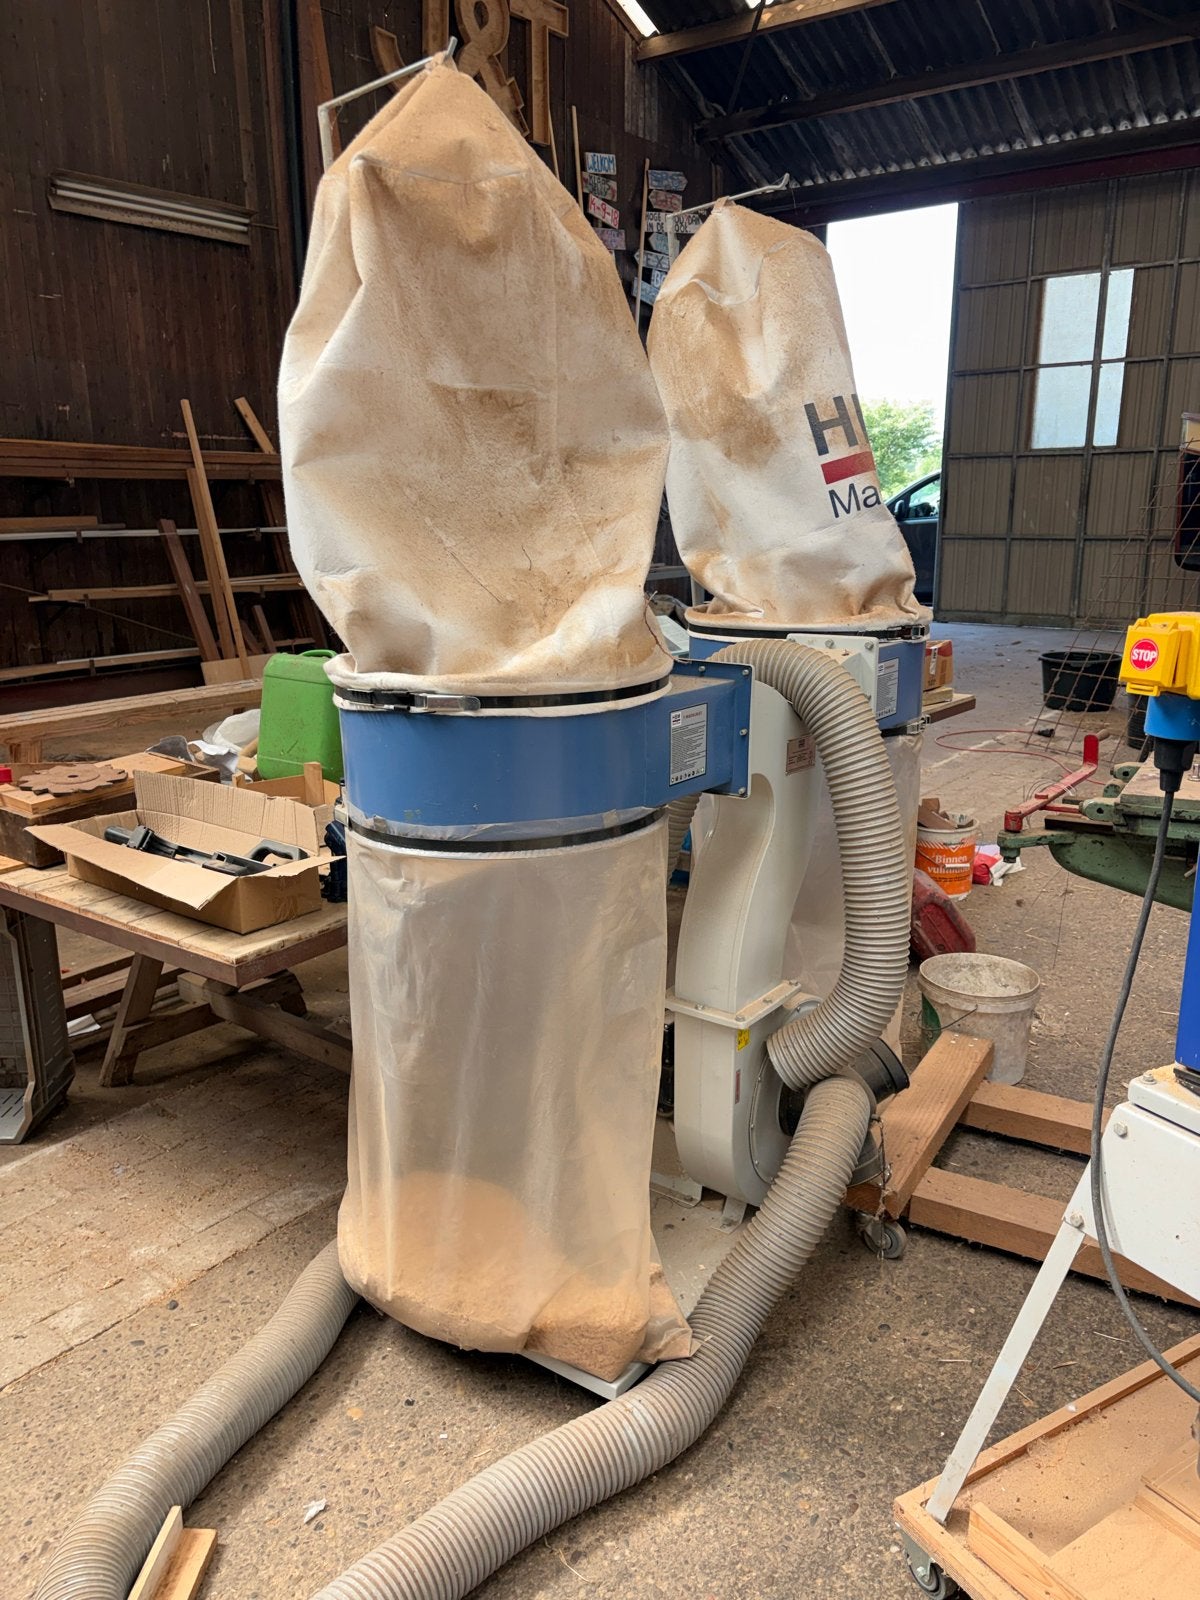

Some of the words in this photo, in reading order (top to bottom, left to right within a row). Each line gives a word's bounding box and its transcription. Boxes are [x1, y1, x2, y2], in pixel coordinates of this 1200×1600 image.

[369, 0, 569, 145] J&T
[587, 153, 616, 173] WELKOM
[804, 394, 869, 456] H
[1132, 649, 1157, 662] STOP
[936, 854, 967, 863] Binnen
